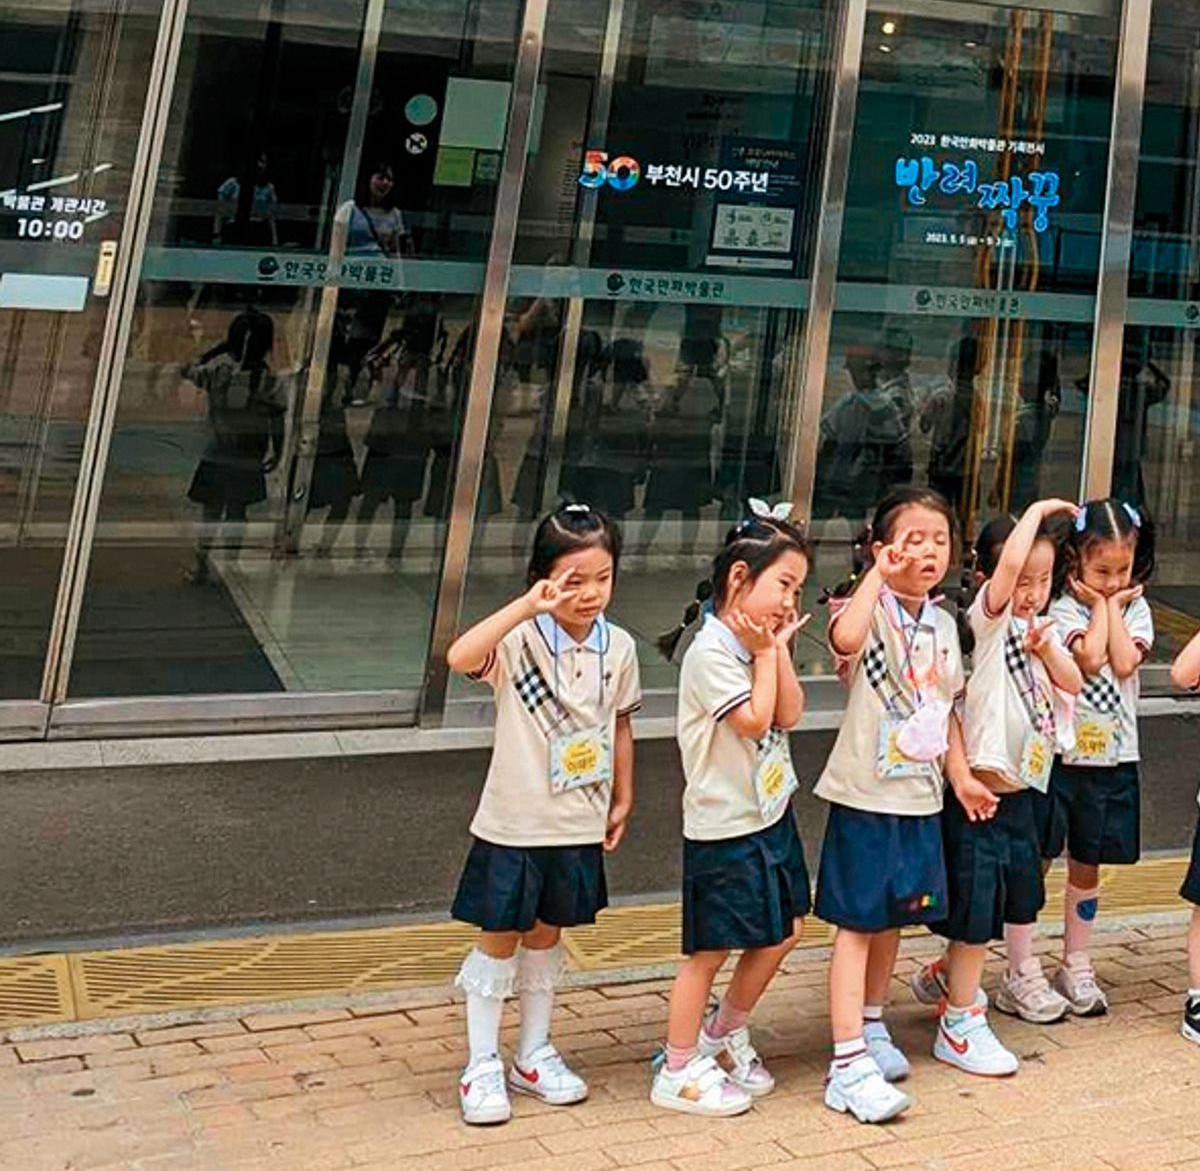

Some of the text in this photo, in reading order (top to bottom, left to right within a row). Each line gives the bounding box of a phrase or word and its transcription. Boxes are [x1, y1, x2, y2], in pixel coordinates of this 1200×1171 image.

[578, 150, 640, 192] 50
[645, 164, 699, 189] 부천시
[703, 168, 769, 193] 50주년
[17, 217, 85, 240] 10:00
[284, 261, 394, 284] 한국만박물관
